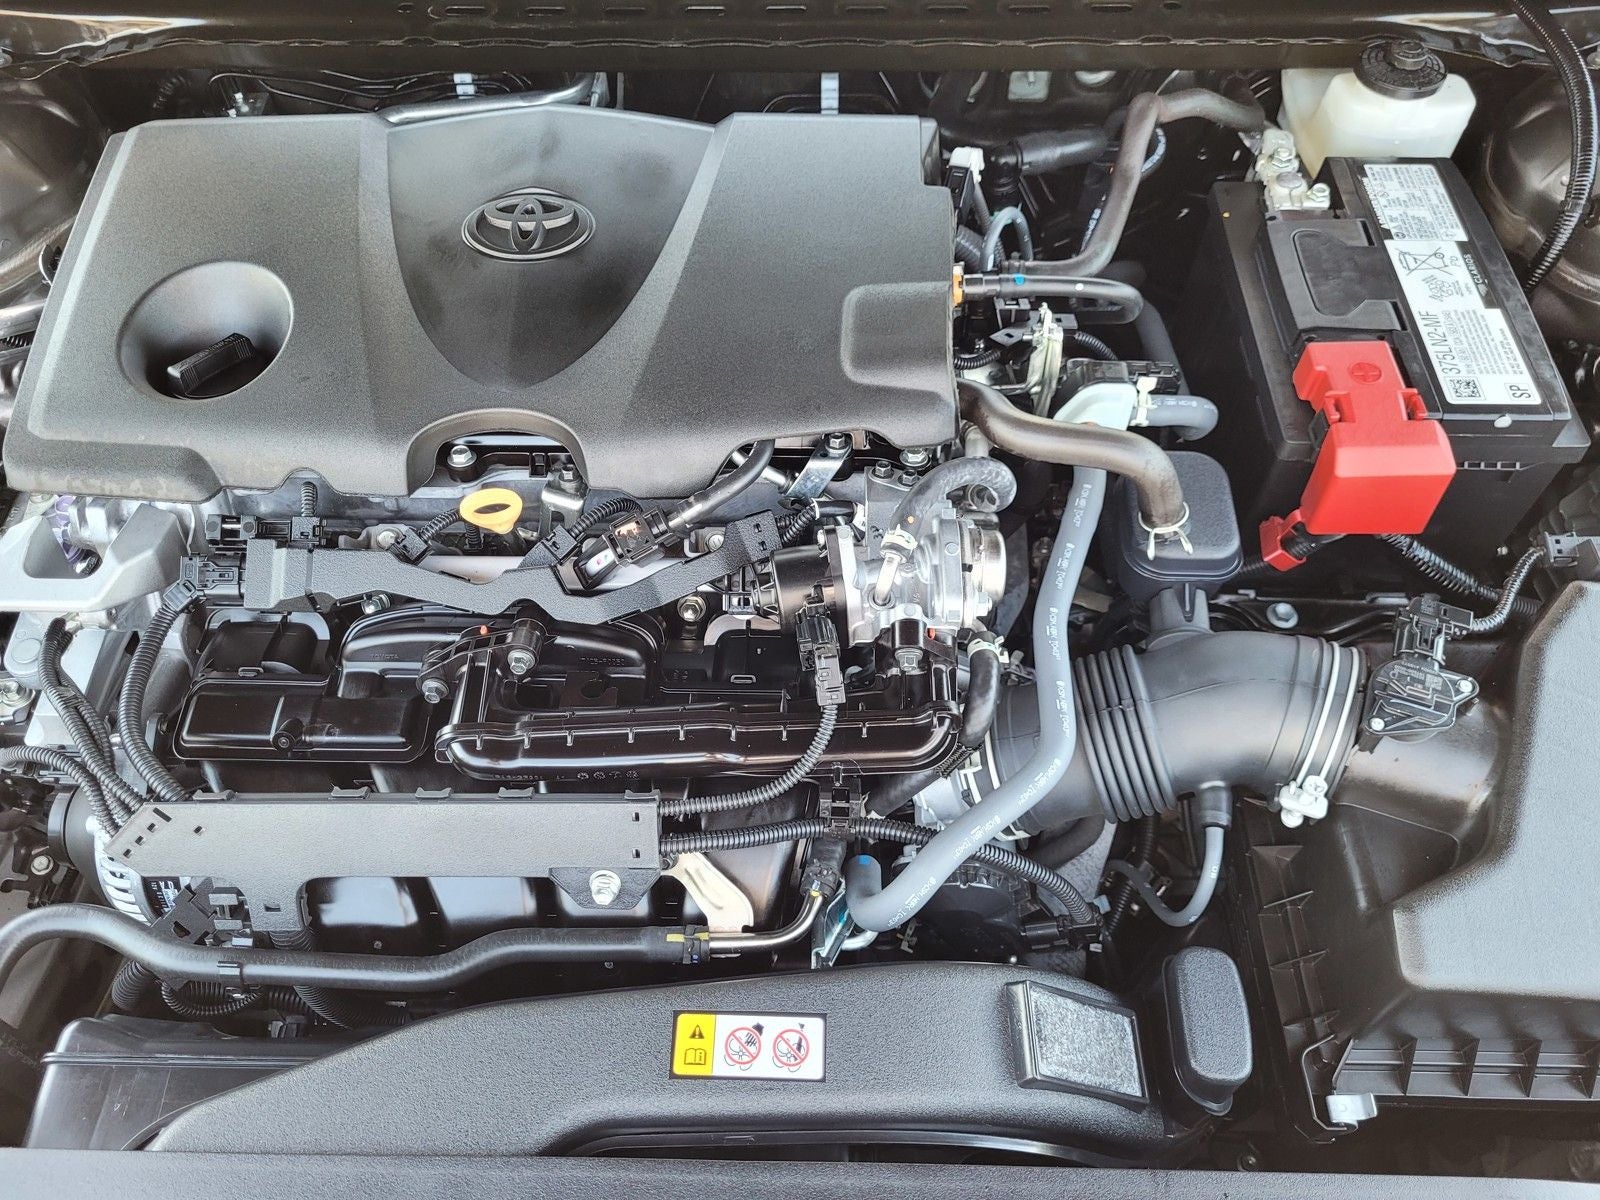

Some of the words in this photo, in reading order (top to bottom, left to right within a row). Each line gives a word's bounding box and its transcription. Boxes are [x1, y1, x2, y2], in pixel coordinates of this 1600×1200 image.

[1463, 253, 1483, 284] CLARIOS
[1418, 310, 1461, 374] 375LN2-MF
[1509, 384, 1531, 399] SP
